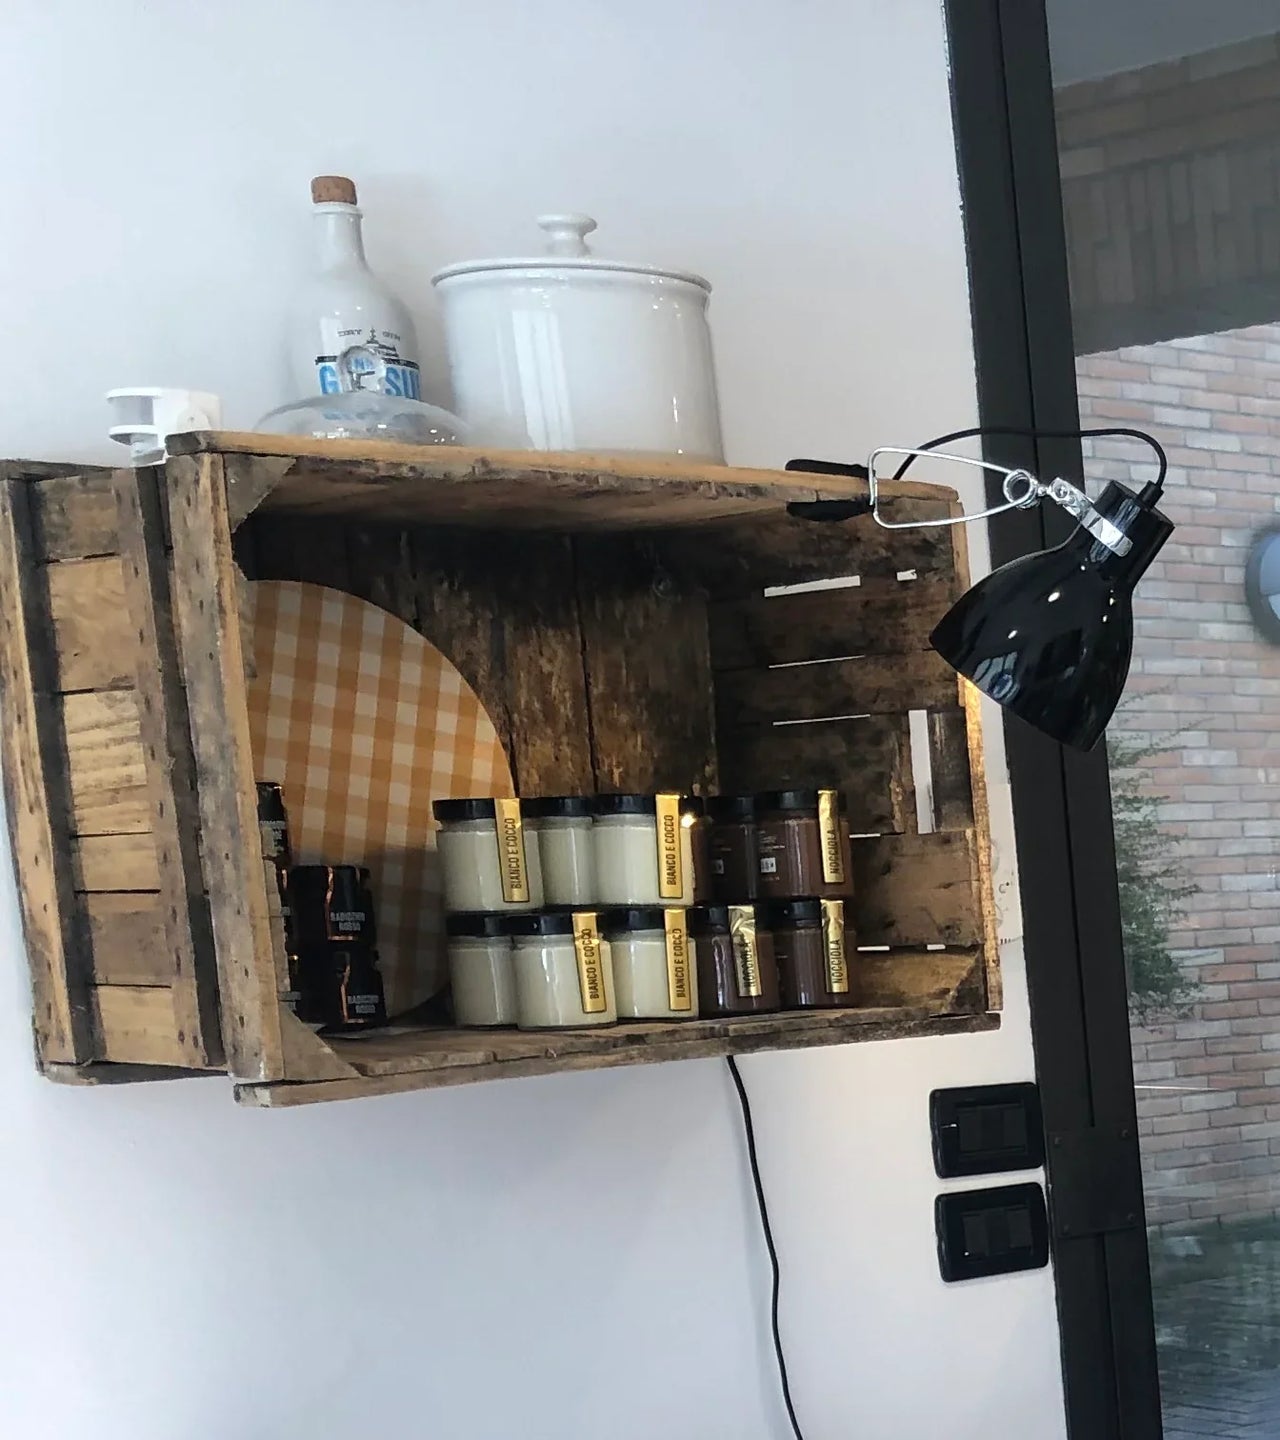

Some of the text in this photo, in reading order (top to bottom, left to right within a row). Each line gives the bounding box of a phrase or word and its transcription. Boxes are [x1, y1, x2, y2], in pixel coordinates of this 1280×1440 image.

[668, 814, 676, 845] COCCO
[827, 828, 840, 875] NOCCIOLA
[831, 938, 843, 984] NOCCIOLA
